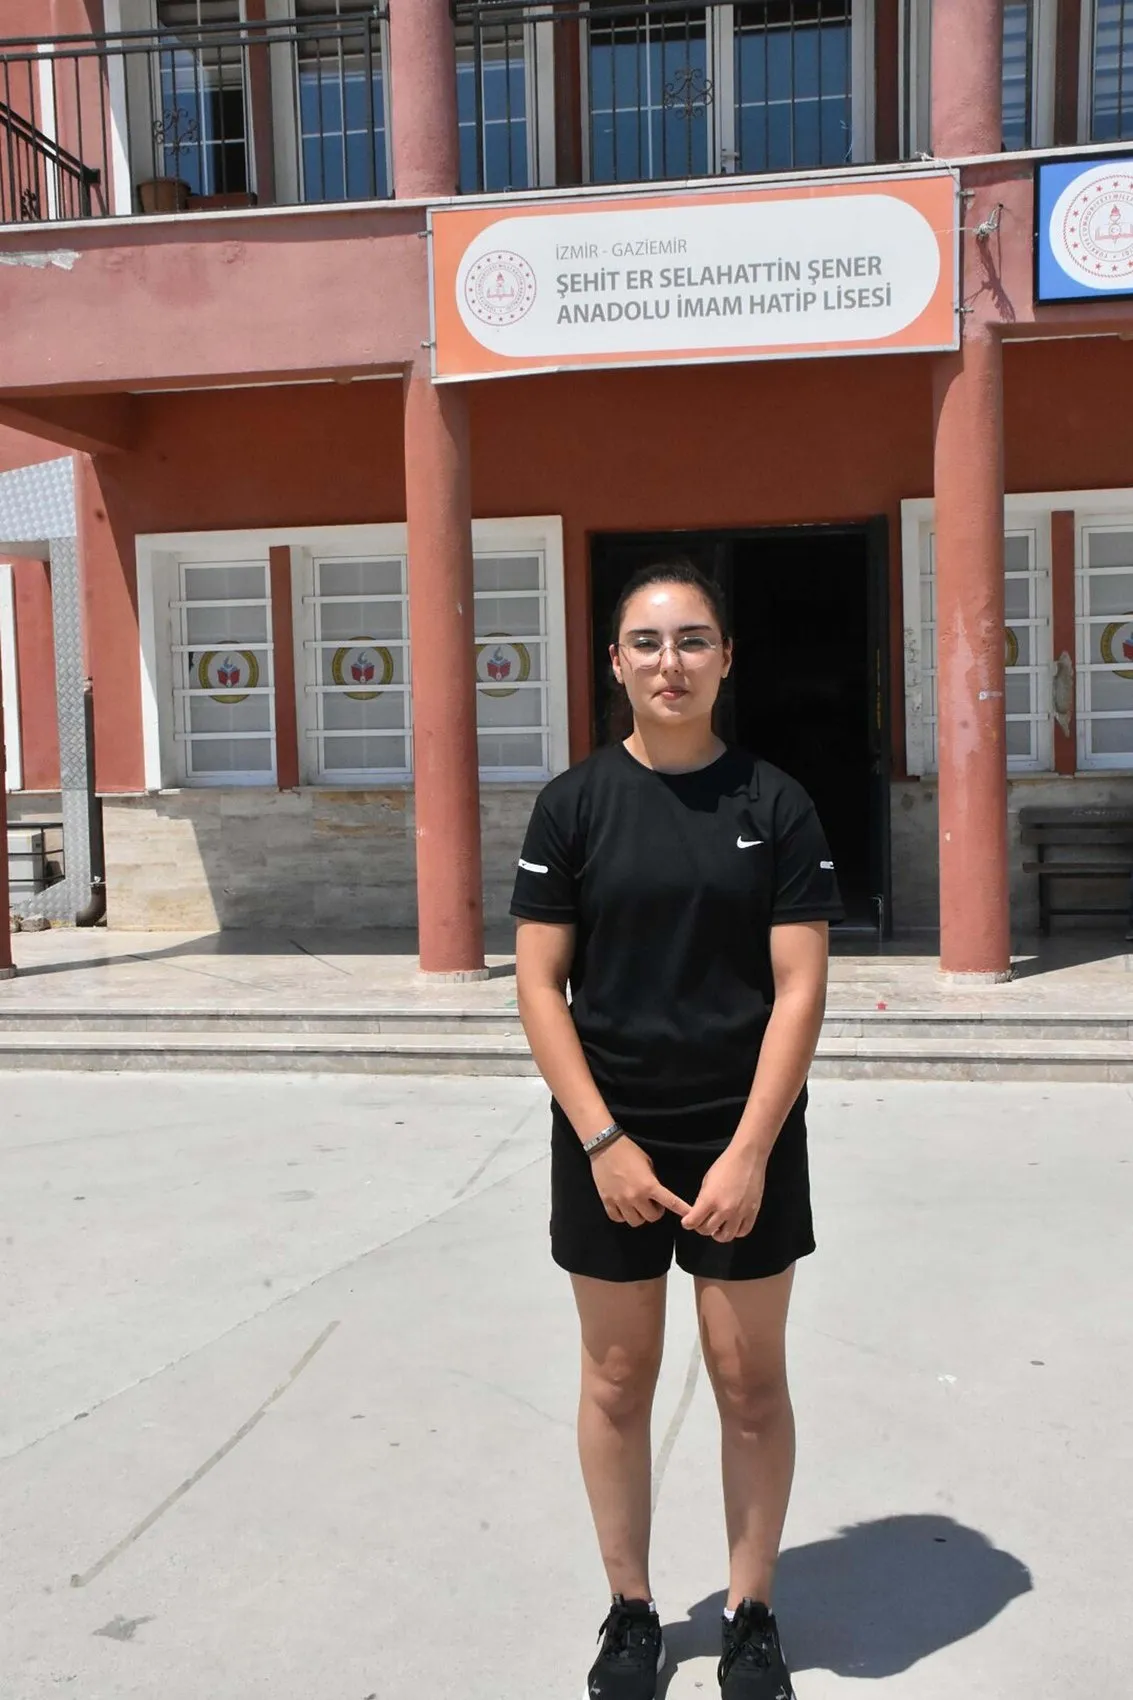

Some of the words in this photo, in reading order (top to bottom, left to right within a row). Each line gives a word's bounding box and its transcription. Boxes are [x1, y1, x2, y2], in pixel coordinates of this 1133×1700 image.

[556, 241, 599, 261] İZMİR
[611, 237, 688, 257] GAZİEMİR
[556, 267, 620, 298] ŞEHİT
[626, 269, 654, 290] ER
[659, 257, 801, 288] SELAHATTİN
[807, 255, 882, 285] ŞENER
[557, 299, 670, 325] ANADOLU
[677, 294, 743, 318] İMAM
[749, 288, 817, 315] HATİP
[823, 282, 892, 311] LİSESİ
